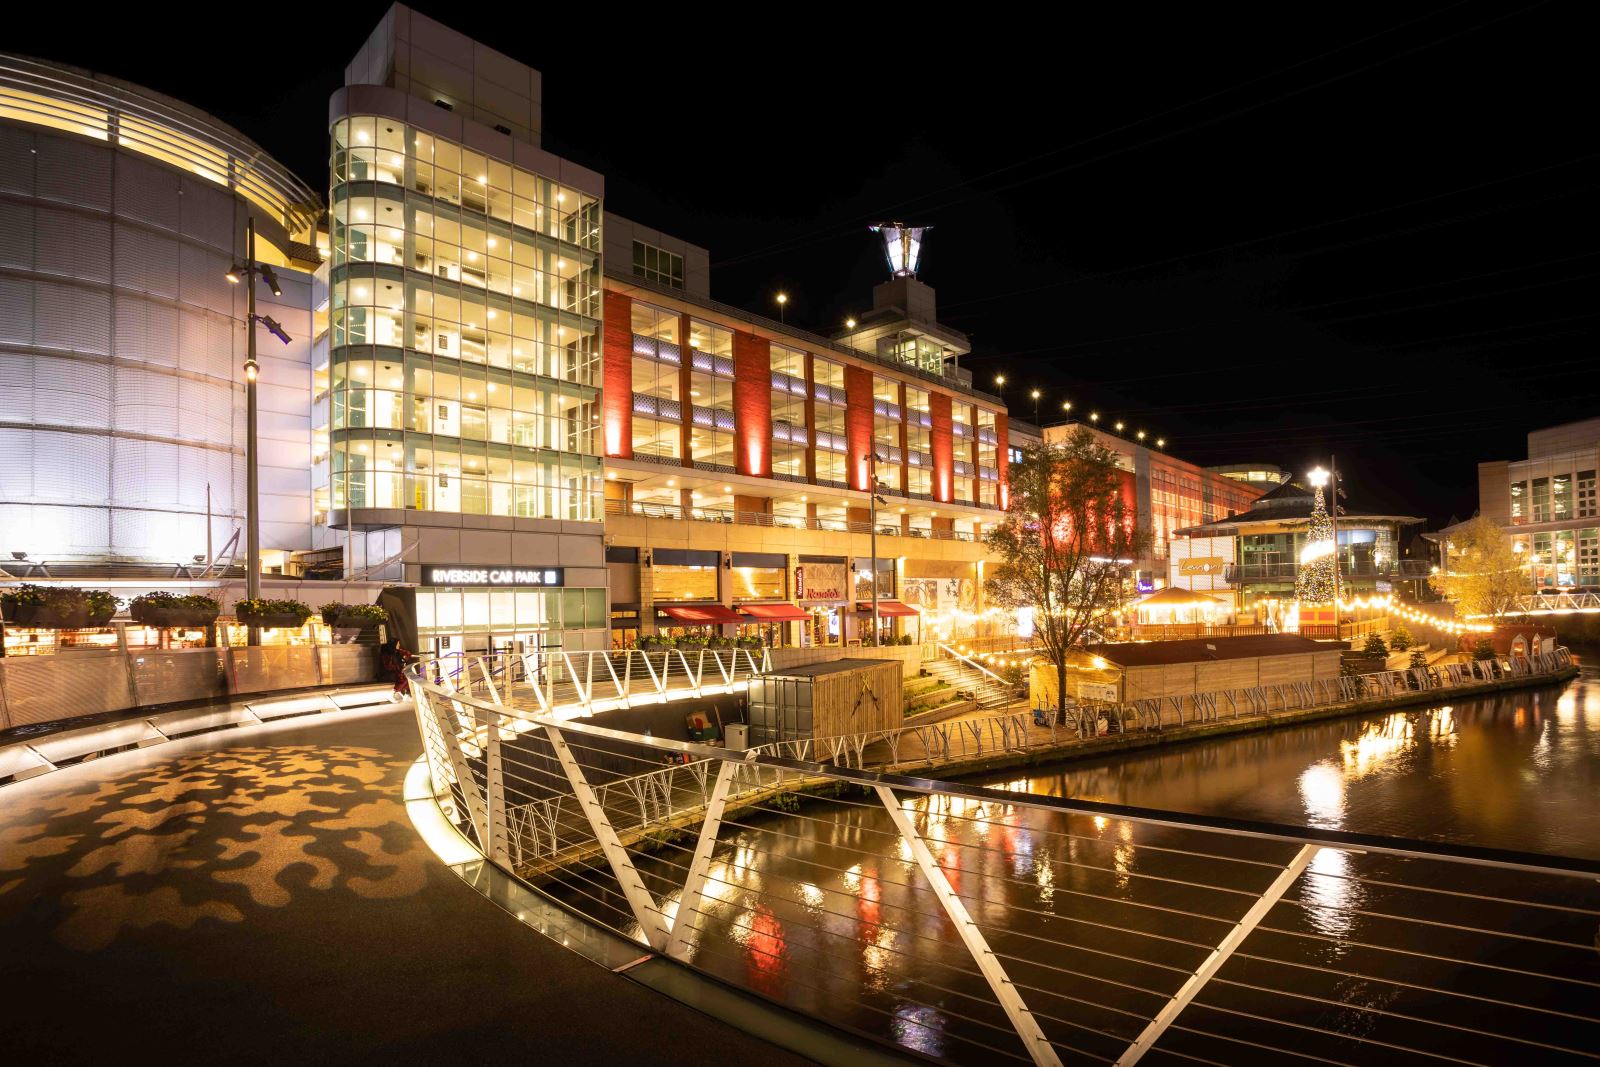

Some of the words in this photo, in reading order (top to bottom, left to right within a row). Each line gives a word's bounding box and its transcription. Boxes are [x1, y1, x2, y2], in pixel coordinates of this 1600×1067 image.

[433, 569, 488, 583] RIVERSIDE
[489, 569, 513, 583] CAR
[515, 570, 541, 583] PARK
